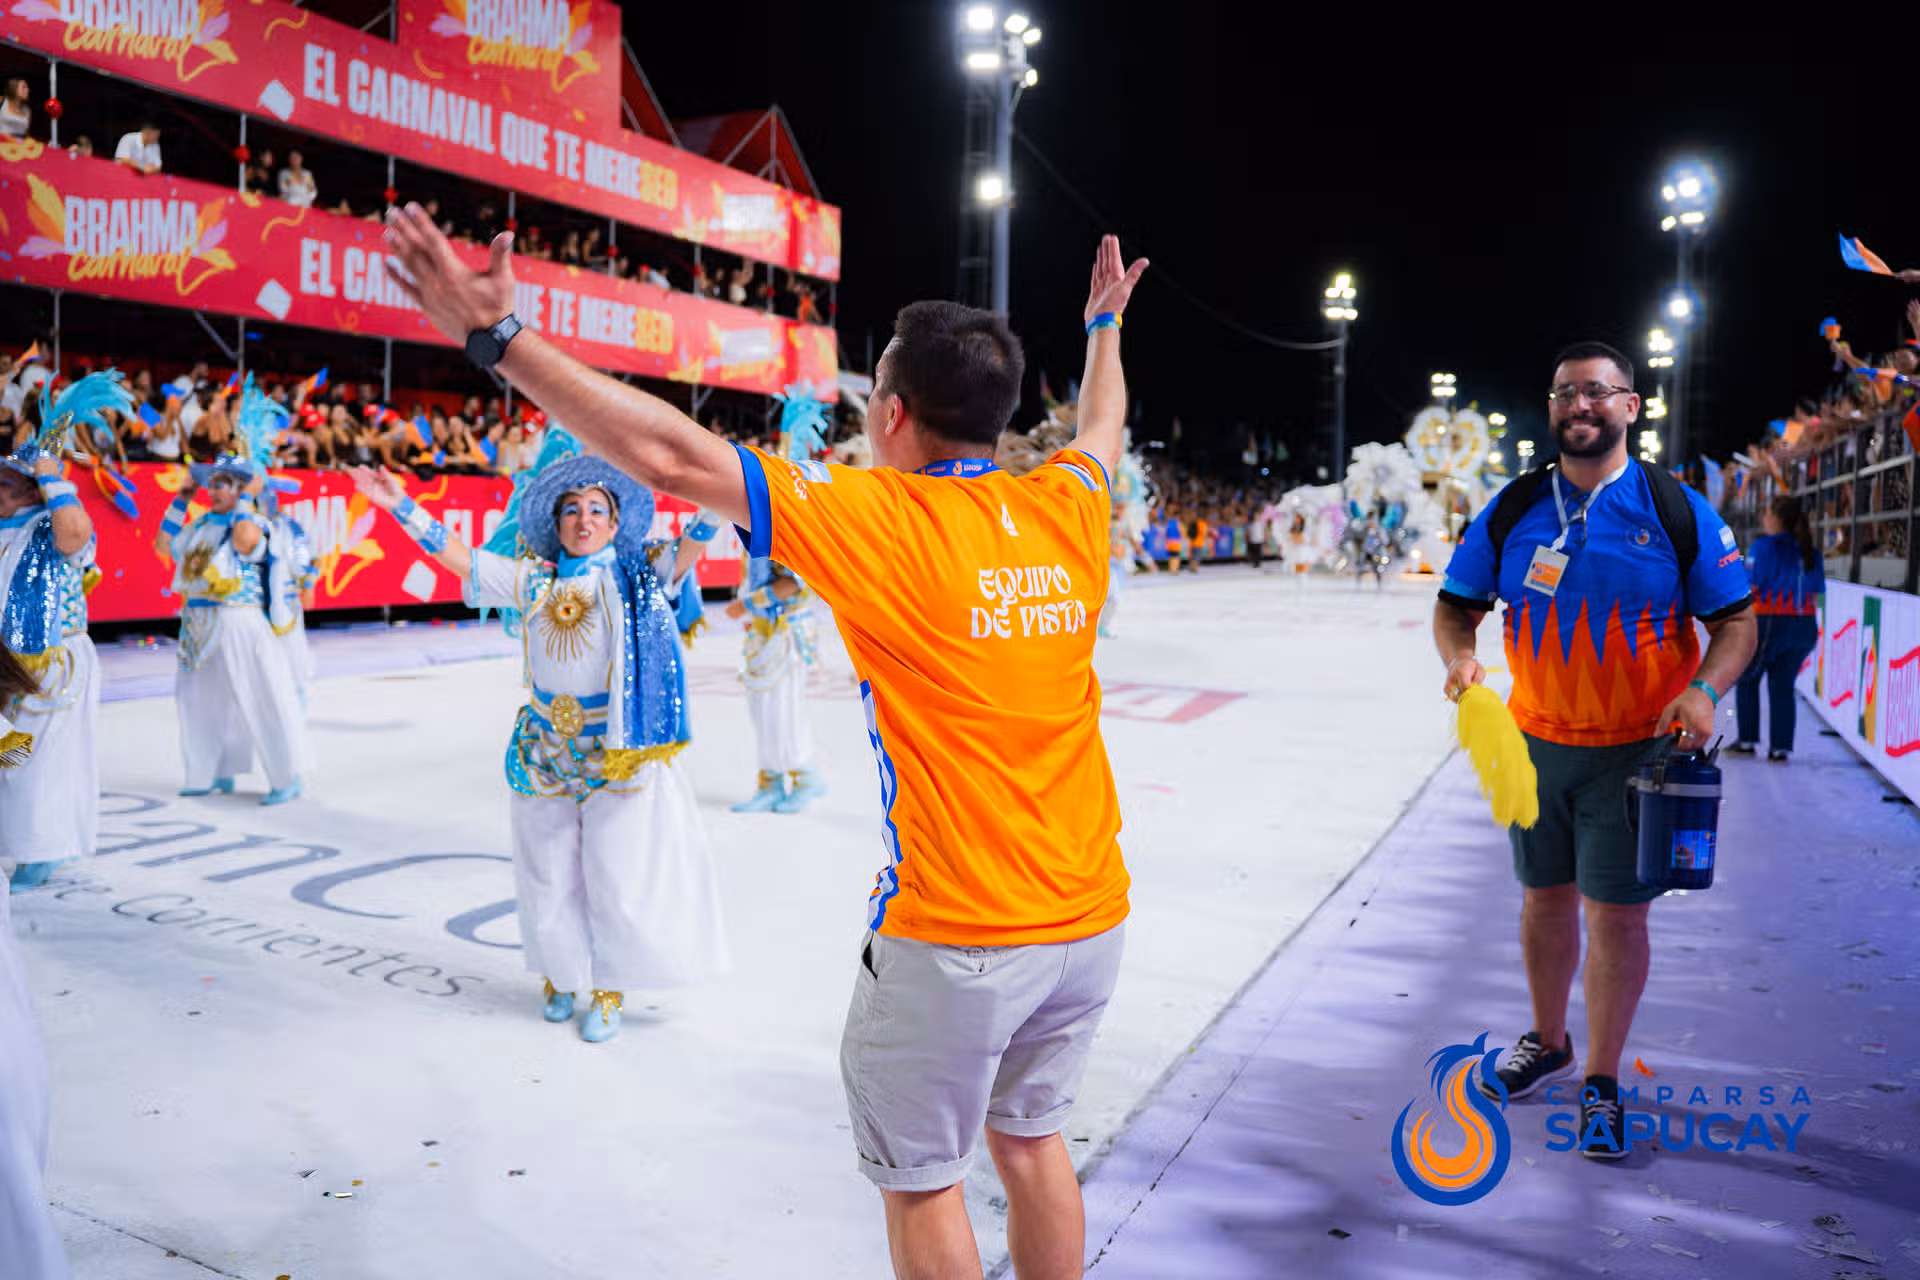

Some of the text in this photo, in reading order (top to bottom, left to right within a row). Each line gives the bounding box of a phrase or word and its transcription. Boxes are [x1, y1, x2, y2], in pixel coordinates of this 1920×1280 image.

[63, 18, 222, 80] Carnaval
[304, 43, 340, 107] EL
[348, 58, 495, 155] CARNAVAL
[501, 111, 549, 172] QUE
[553, 128, 581, 182] TE
[63, 195, 201, 258] BRAHMA
[68, 243, 220, 295] Carnaval
[301, 237, 336, 298] EL
[513, 280, 545, 332] UE
[549, 287, 576, 338] TE
[978, 564, 1072, 604] EQUIPO
[970, 599, 1088, 639] DE PISTA
